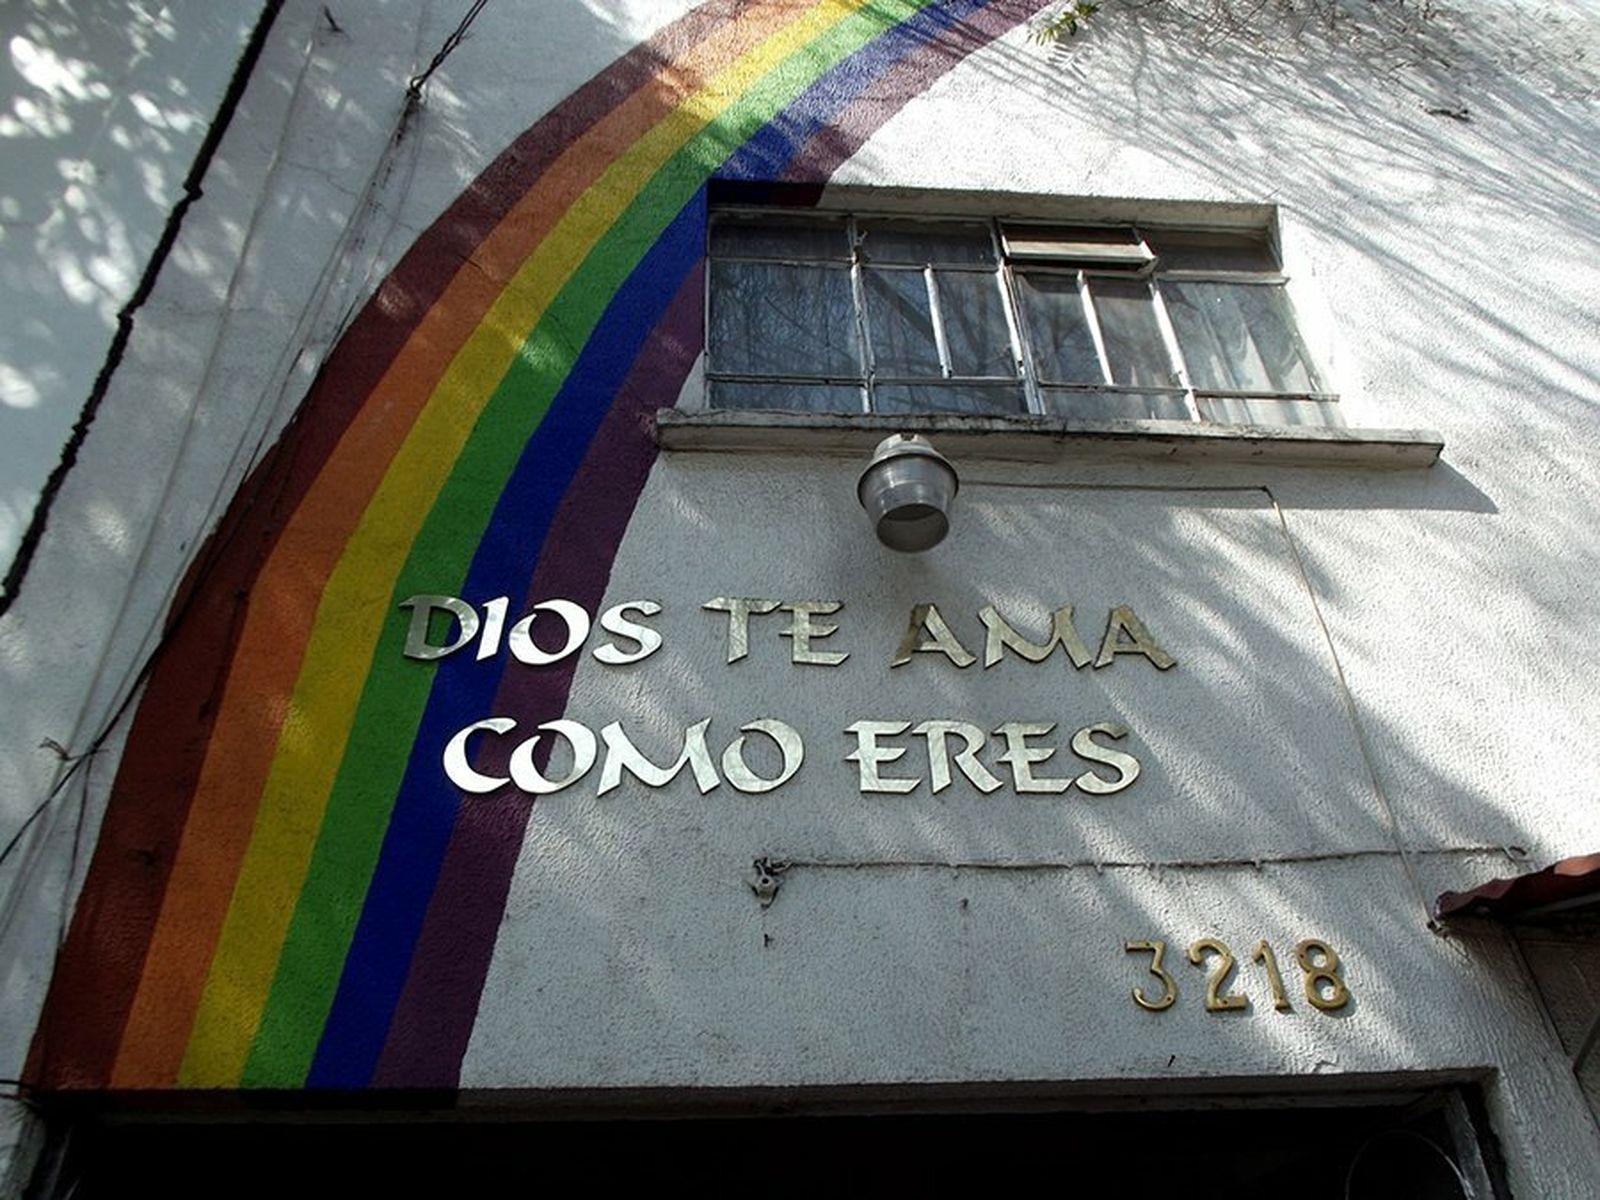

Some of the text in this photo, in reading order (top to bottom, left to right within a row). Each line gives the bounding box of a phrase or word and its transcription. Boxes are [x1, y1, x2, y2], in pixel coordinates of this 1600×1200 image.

[398, 595, 1178, 670] DIOS TE AMA
[443, 717, 1141, 796] COMO ERES
[1124, 938, 1349, 1012] 3218
